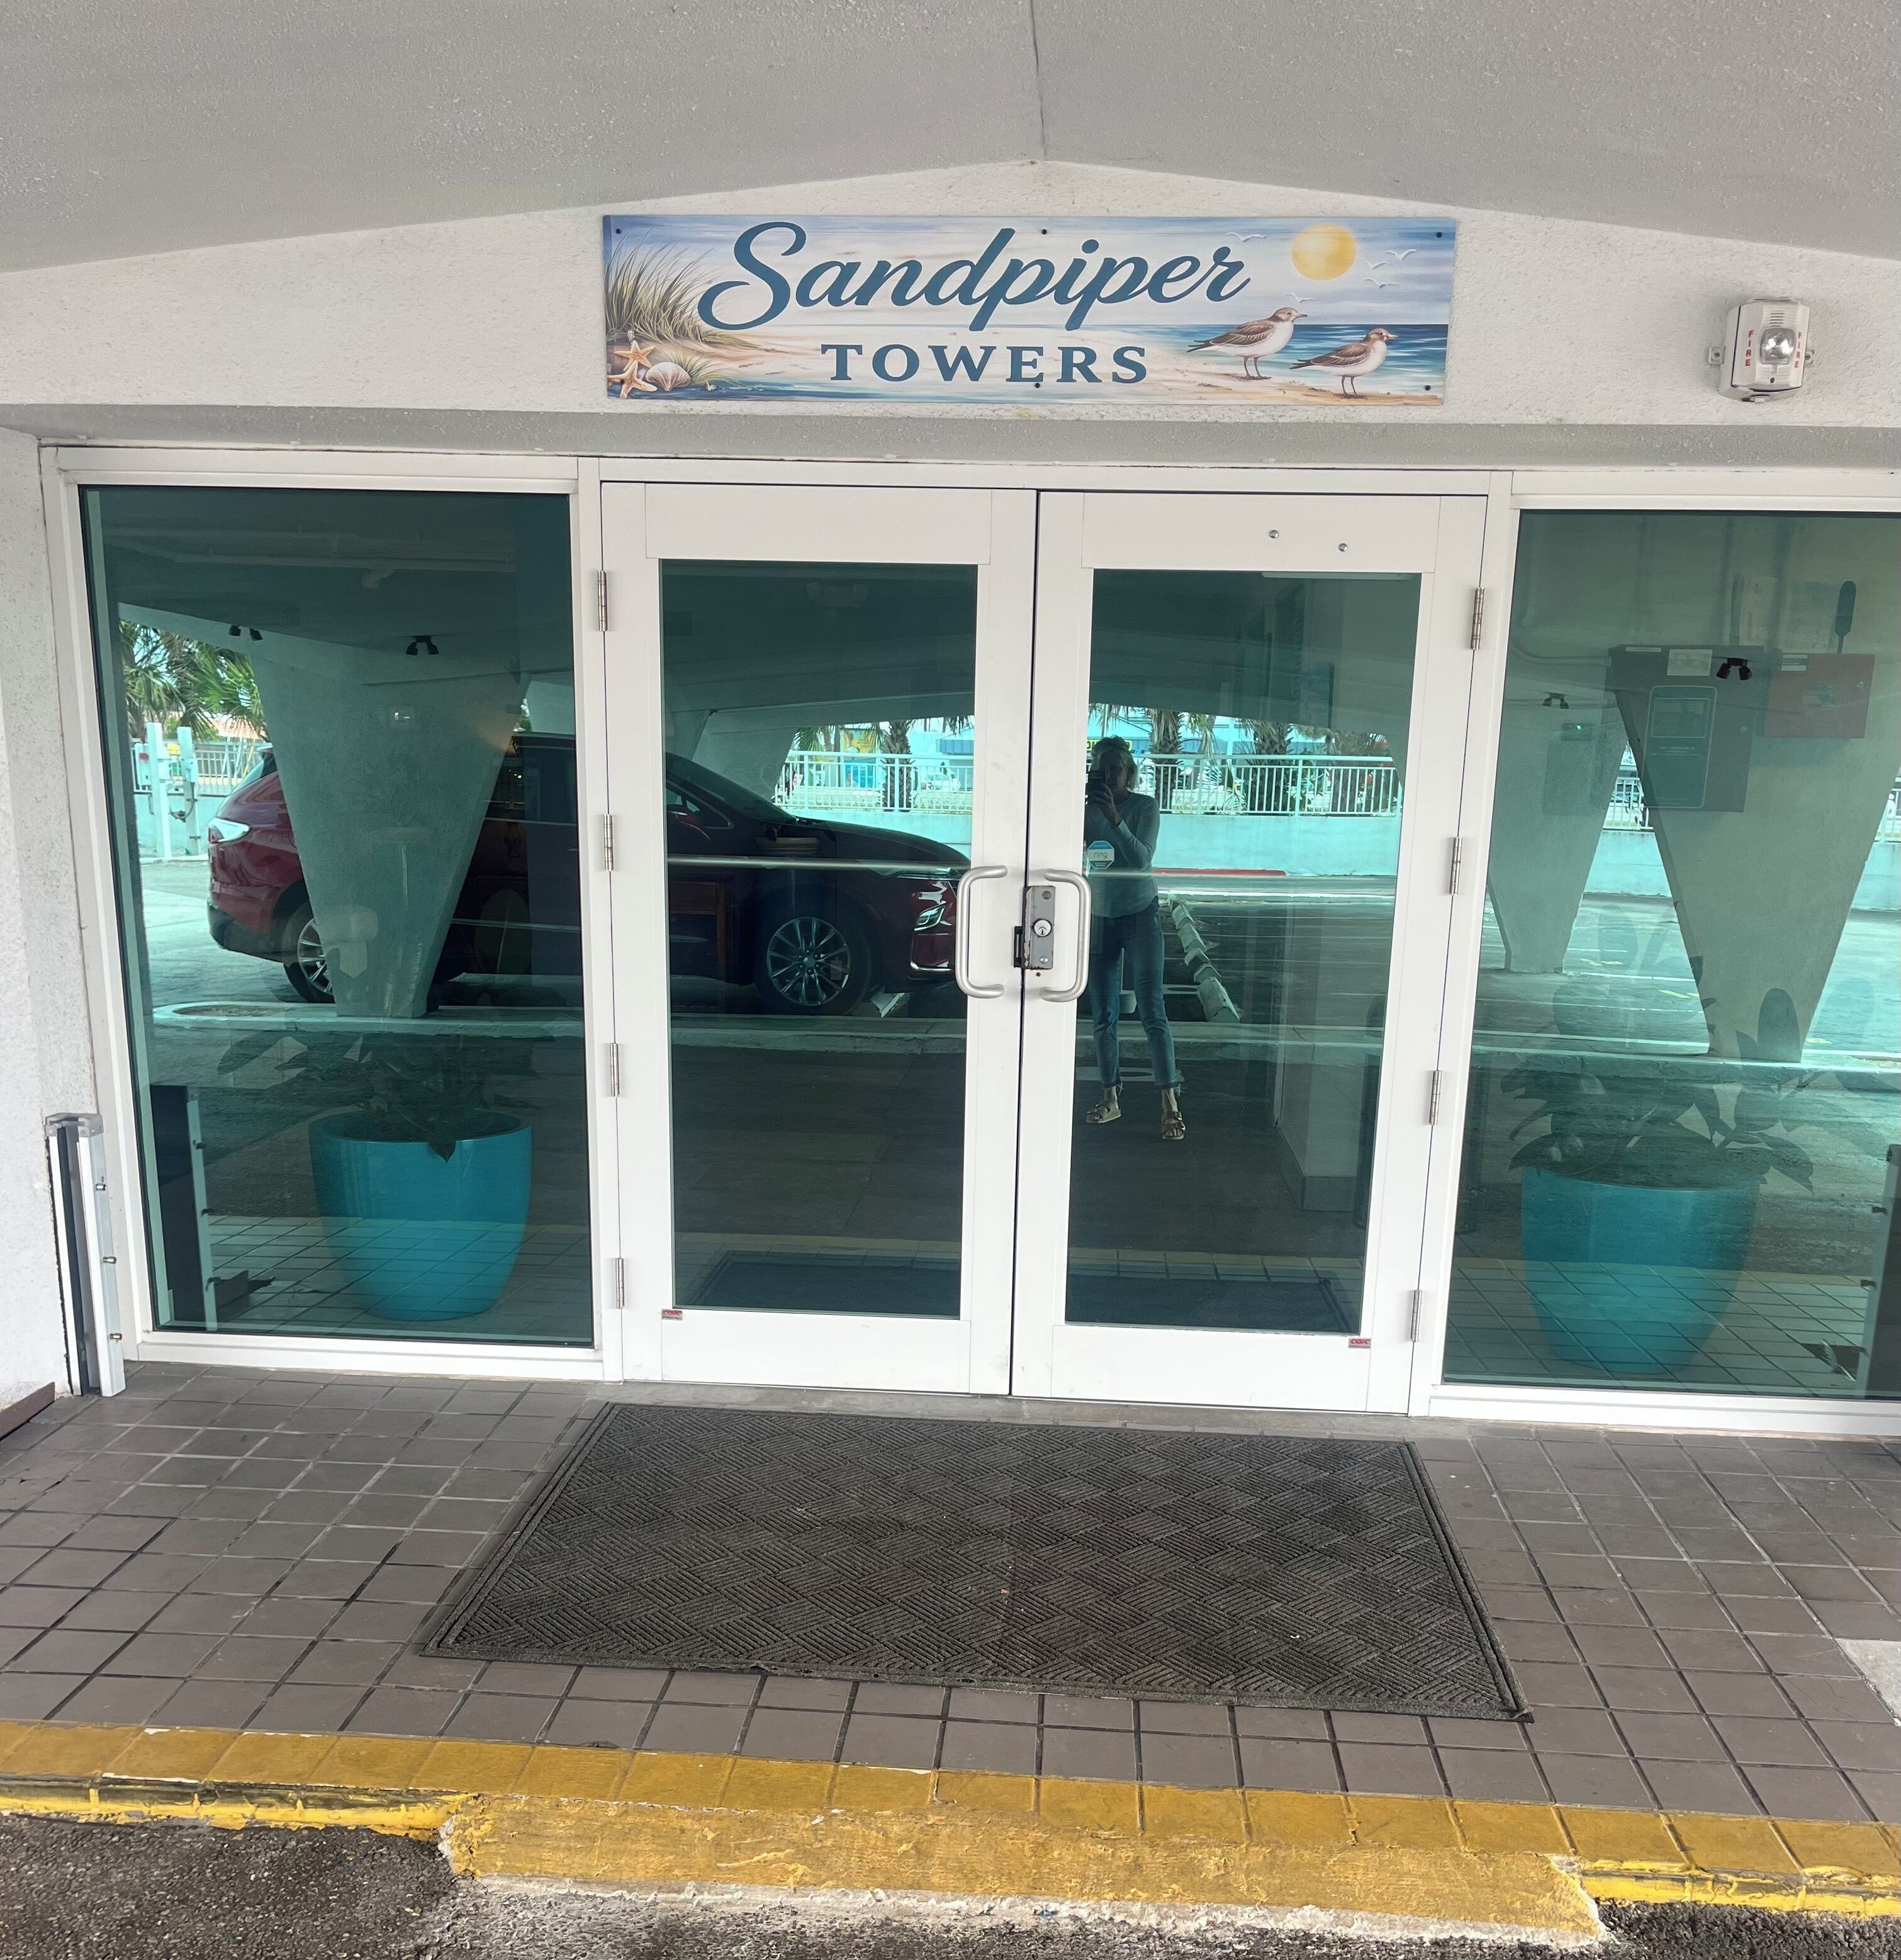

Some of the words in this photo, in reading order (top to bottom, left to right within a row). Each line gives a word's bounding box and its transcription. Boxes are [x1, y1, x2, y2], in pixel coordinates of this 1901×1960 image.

[698, 222, 1250, 331] Sandpiper
[821, 345, 1146, 383] TOWERS
[1745, 330, 1754, 366] FIRE
[1094, 851, 1108, 859] ring
